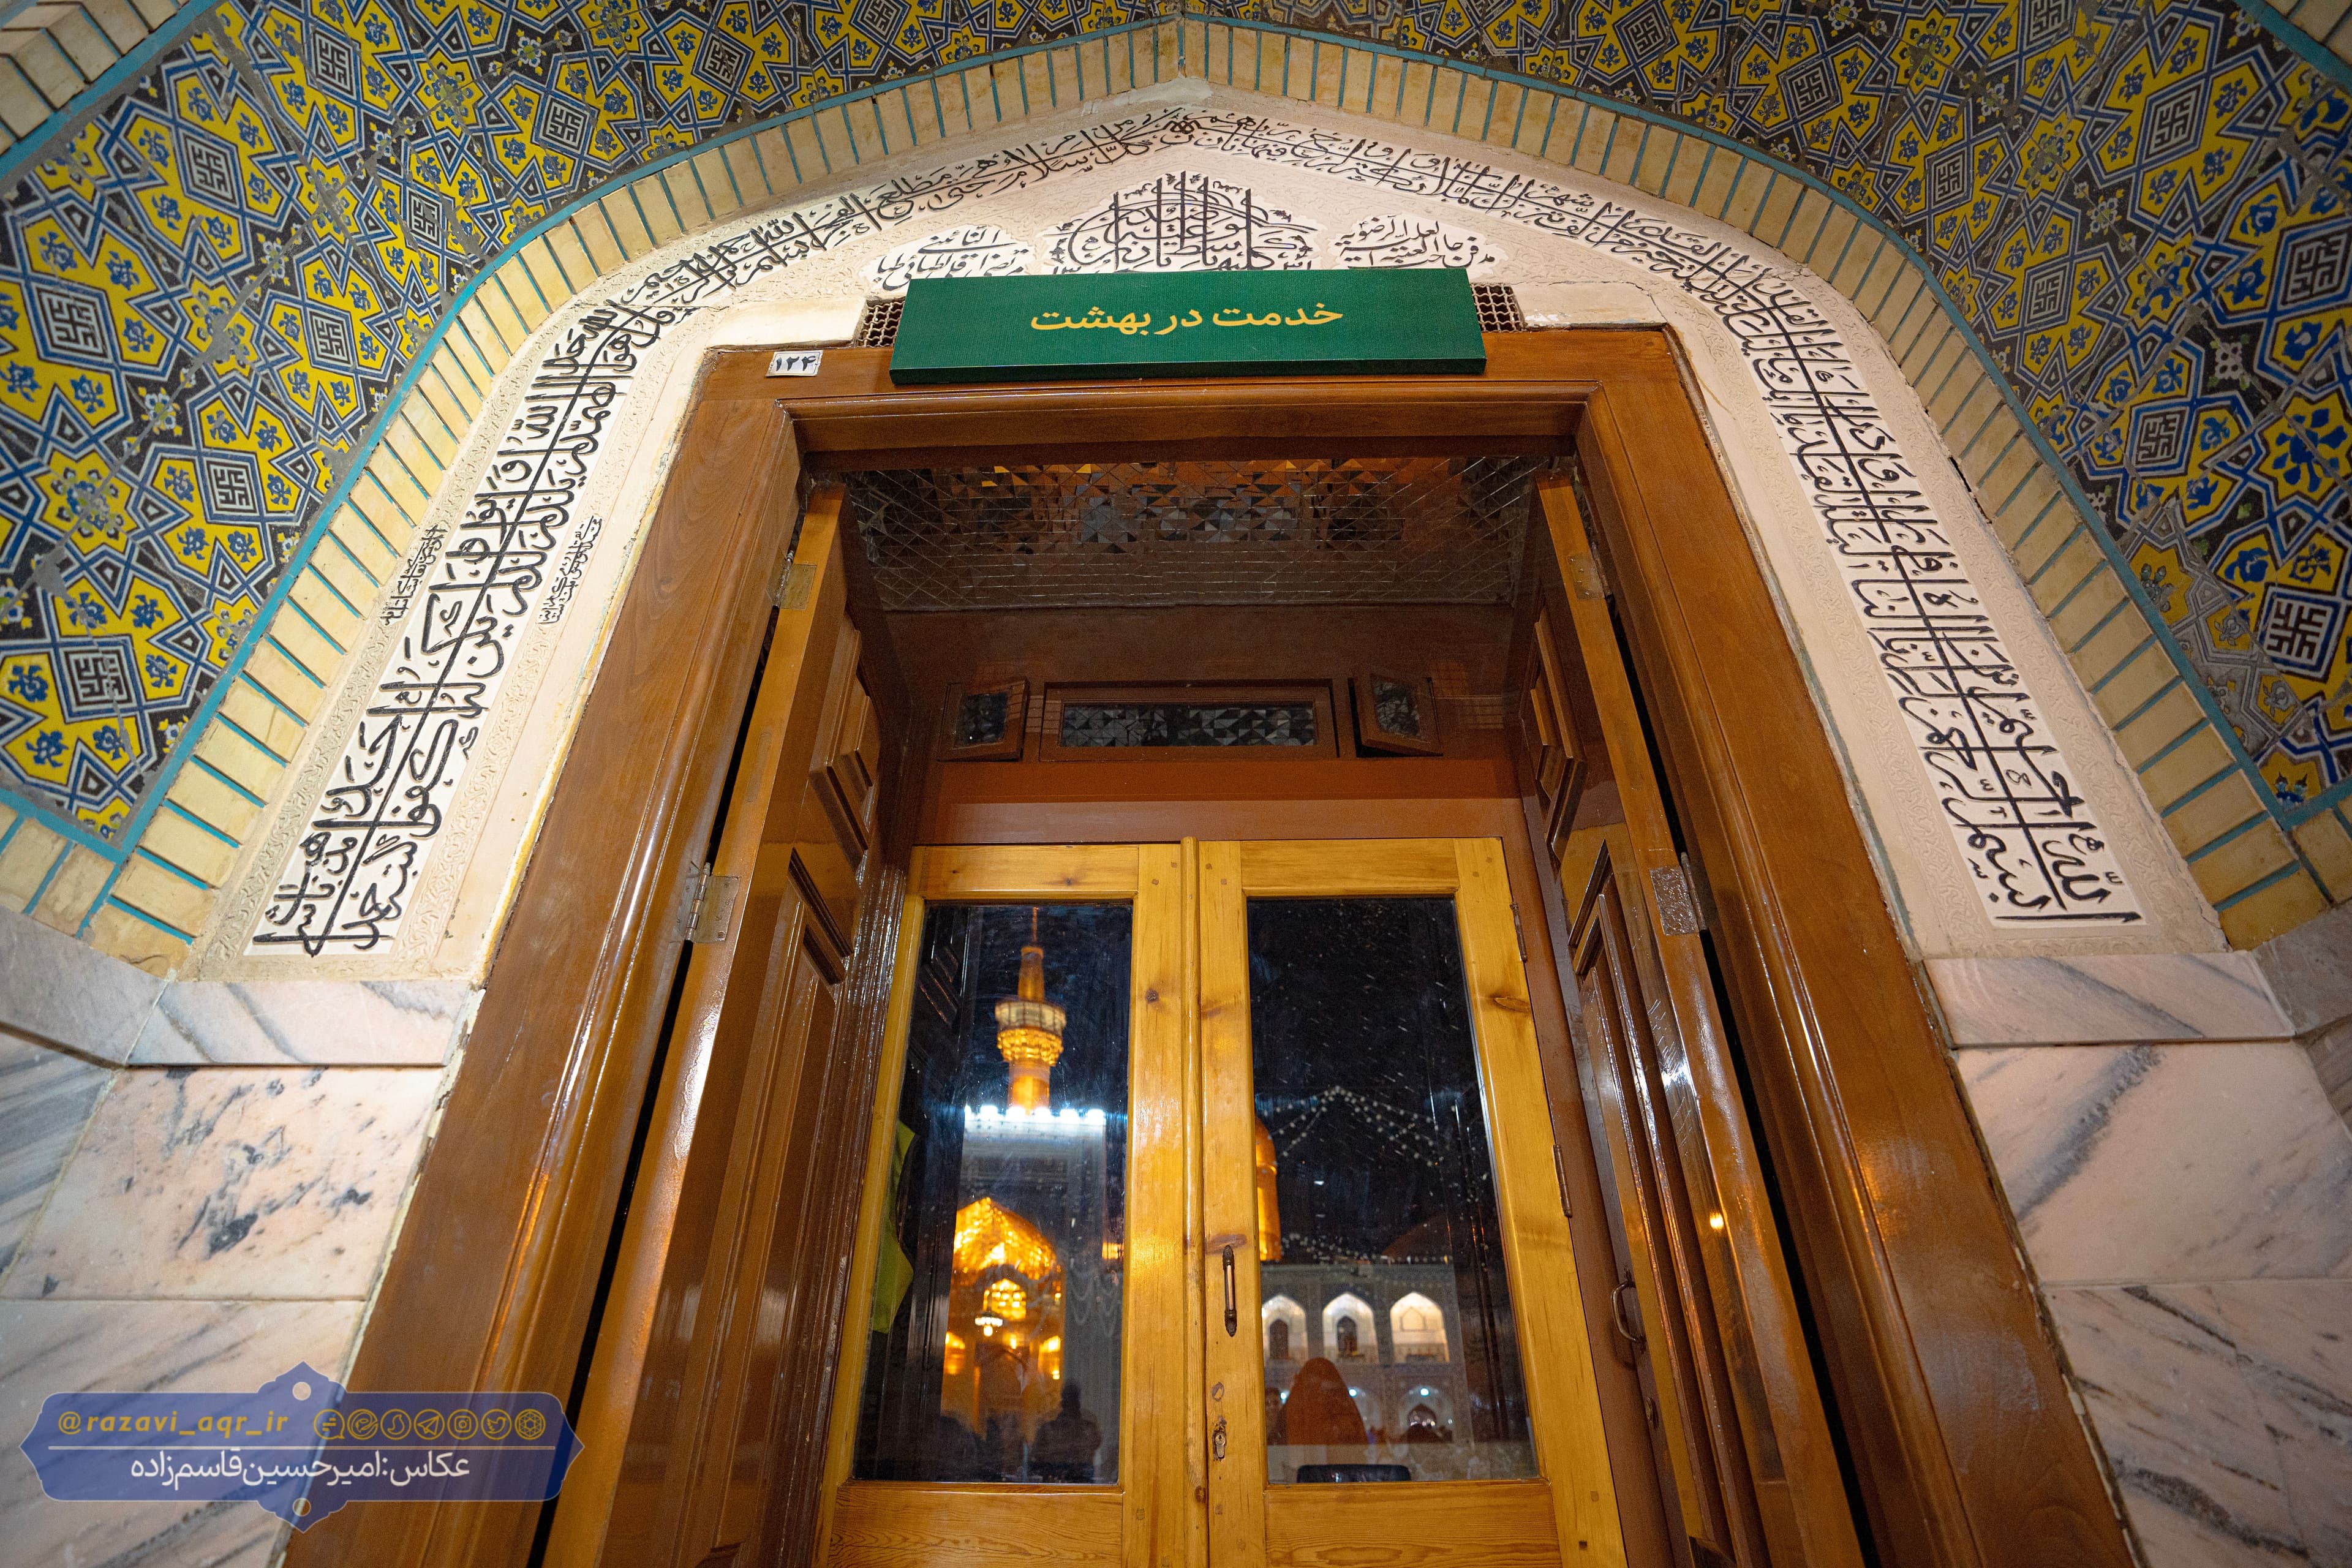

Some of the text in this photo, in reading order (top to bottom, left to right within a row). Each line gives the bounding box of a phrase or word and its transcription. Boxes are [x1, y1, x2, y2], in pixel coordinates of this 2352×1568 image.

[1030, 302, 1344, 336] خدمت در بهشت
[775, 356, 816, 372] ۱۲۴
